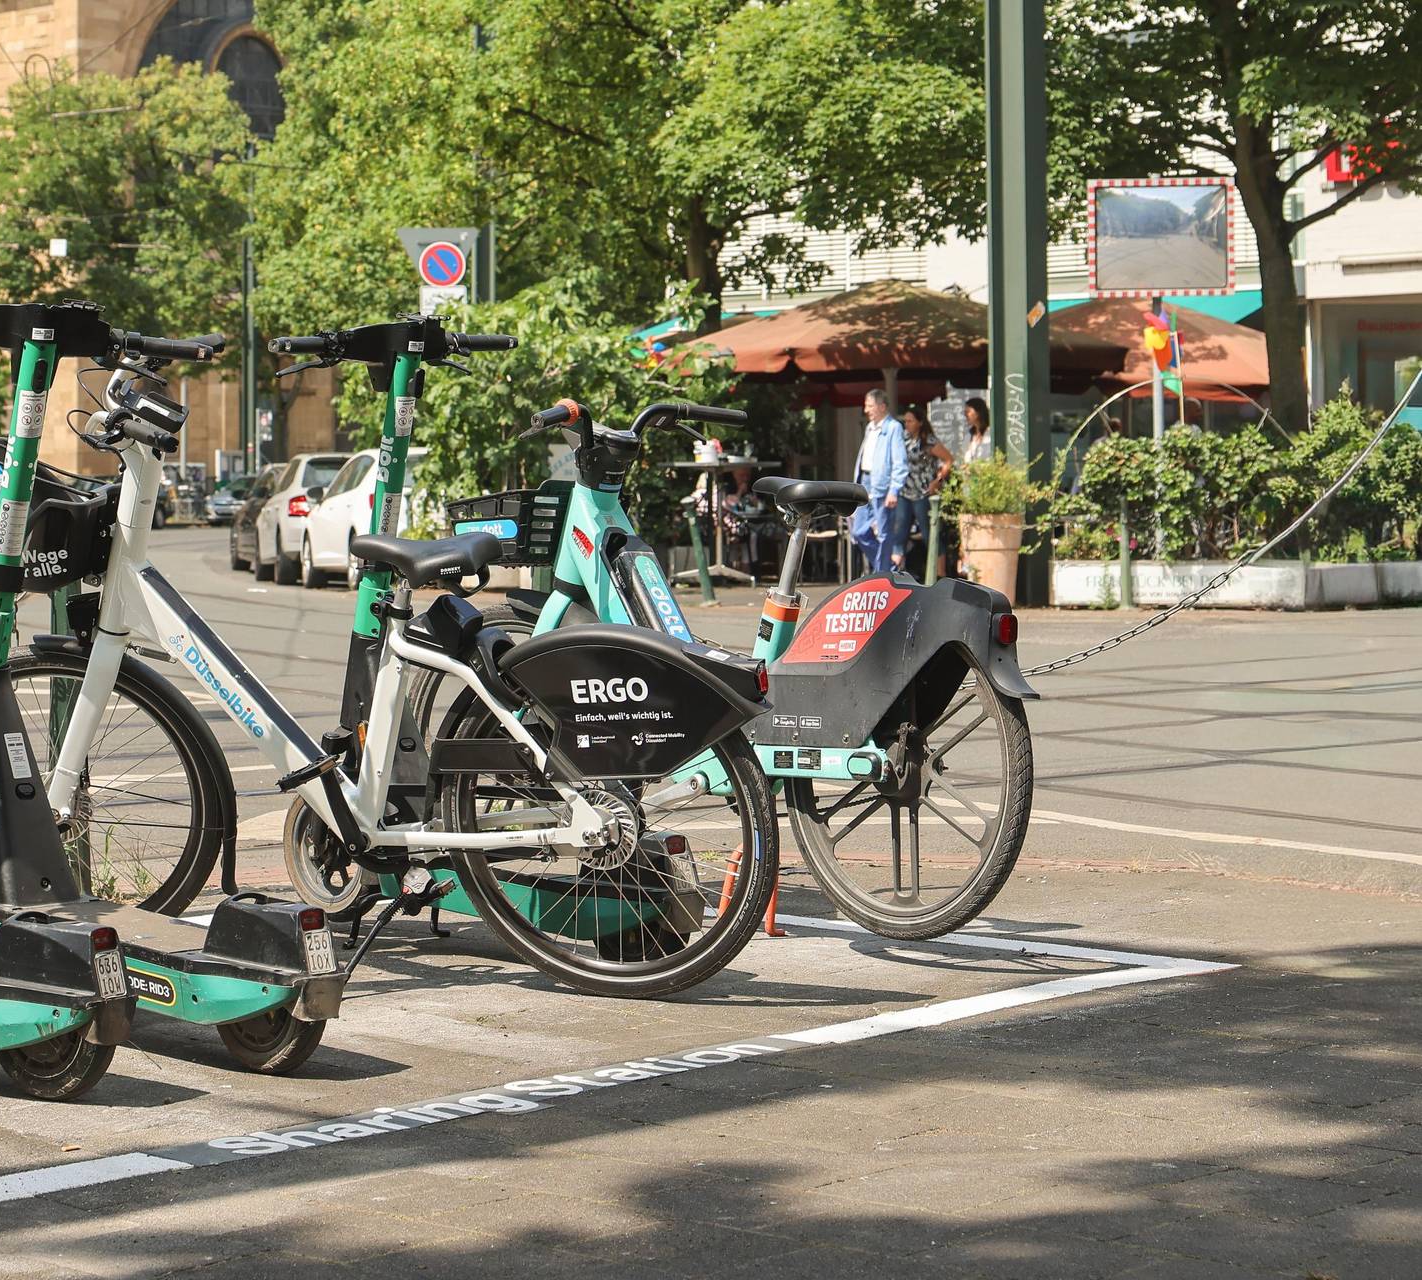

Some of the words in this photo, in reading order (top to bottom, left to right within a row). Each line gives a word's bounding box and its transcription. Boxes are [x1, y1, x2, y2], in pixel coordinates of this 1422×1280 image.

[21, 549, 68, 564] Wege
[32, 562, 68, 577] alle.
[650, 586, 684, 635] dott
[842, 592, 890, 612] GRATIS
[825, 612, 876, 633] TESTEN!
[183, 646, 264, 738] Düsselbike
[570, 677, 649, 704] ERGO
[575, 713, 607, 722] Einfach,
[607, 712, 630, 720] weil's
[631, 711, 660, 721] wichtig
[661, 710, 674, 719] ist.
[308, 935, 328, 951] 256
[98, 957, 118, 975] 636
[149, 981, 170, 998] RID3
[208, 1093, 540, 1156] Sharing
[504, 1043, 770, 1097] Station
